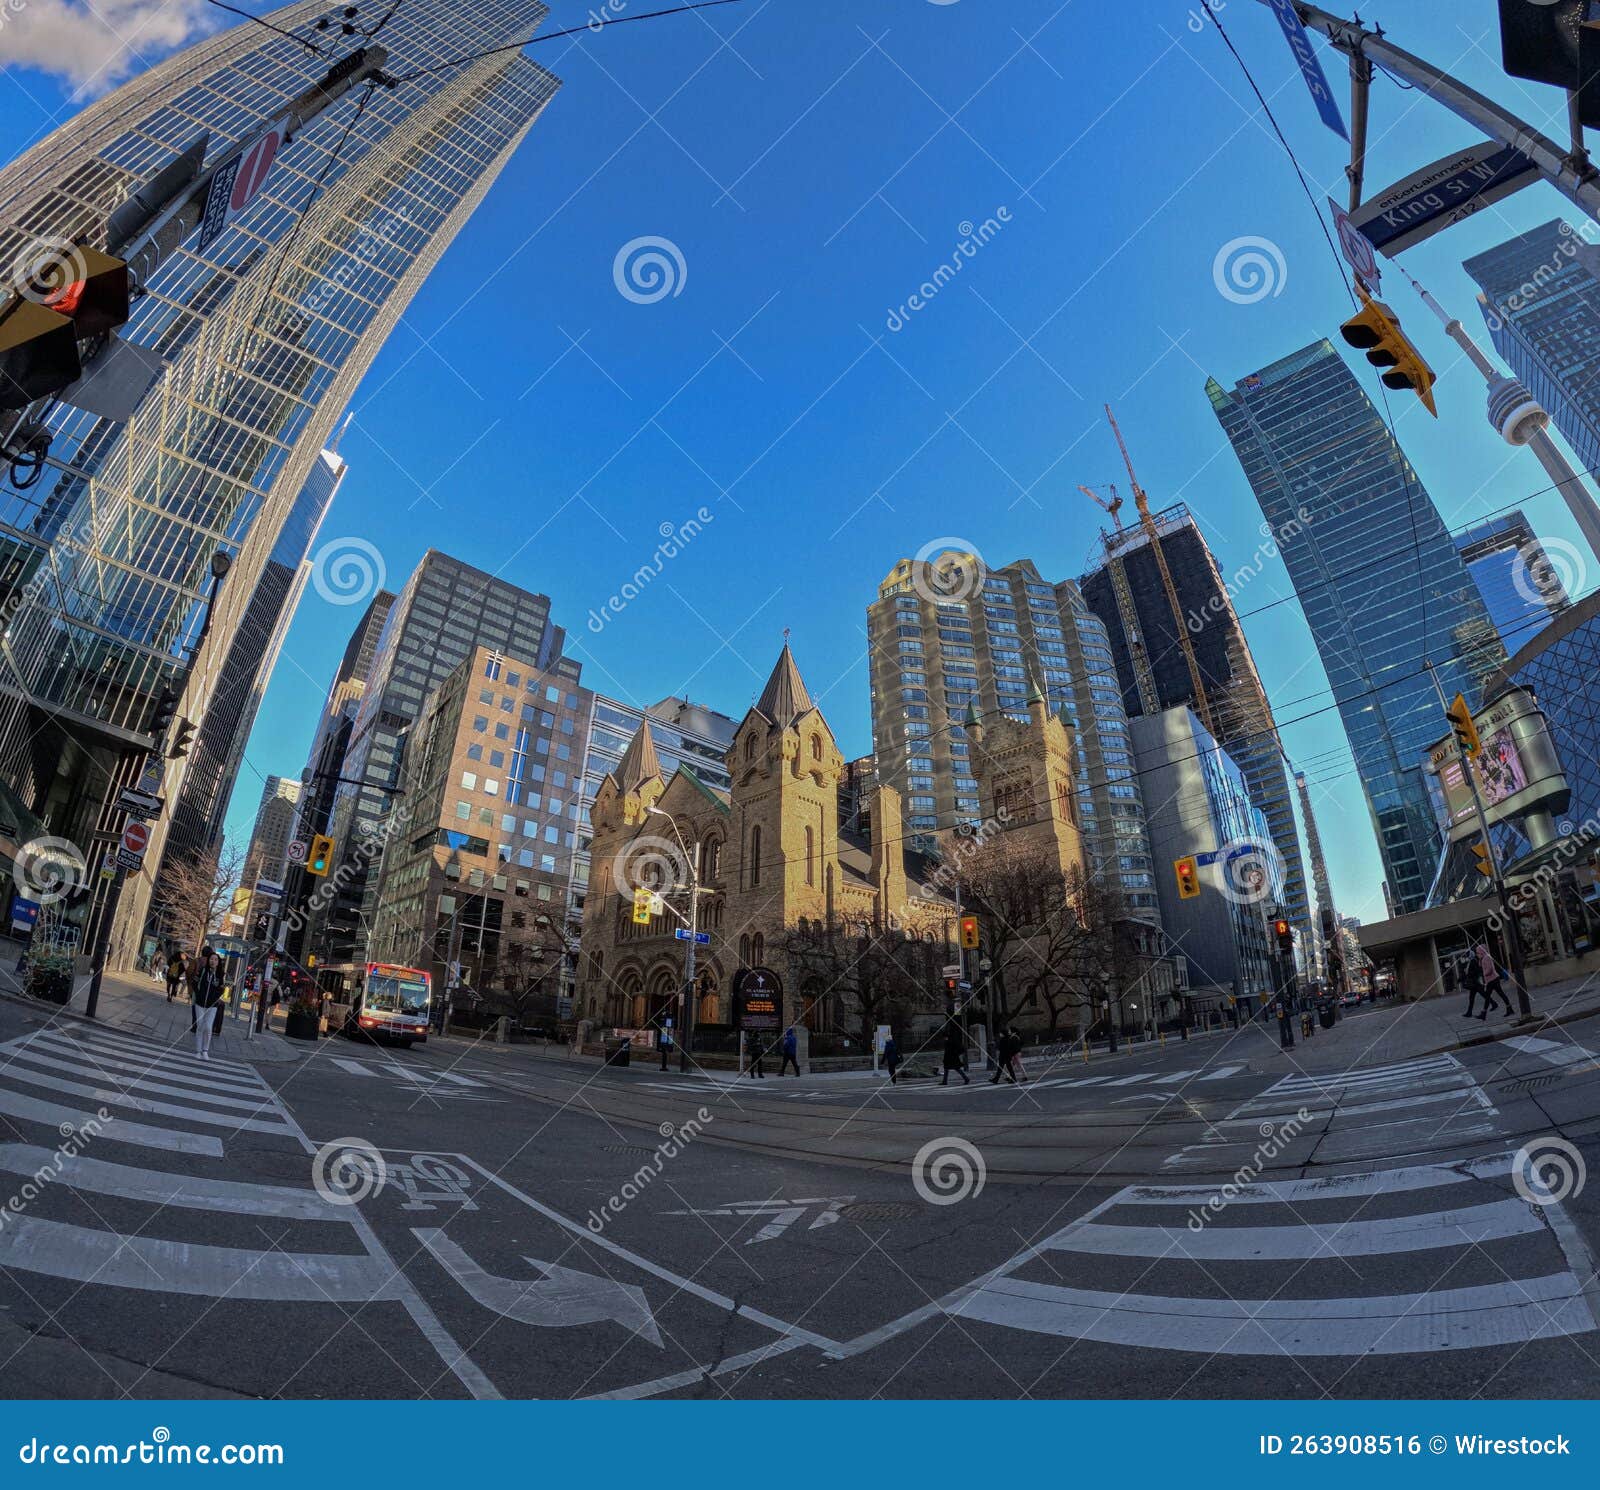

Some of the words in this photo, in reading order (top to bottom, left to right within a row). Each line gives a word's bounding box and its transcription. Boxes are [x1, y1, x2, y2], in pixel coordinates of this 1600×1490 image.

[1380, 156, 1475, 208] entertainment
[1382, 191, 1445, 228] King
[1446, 179, 1471, 195] St
[1468, 161, 1497, 181] W
